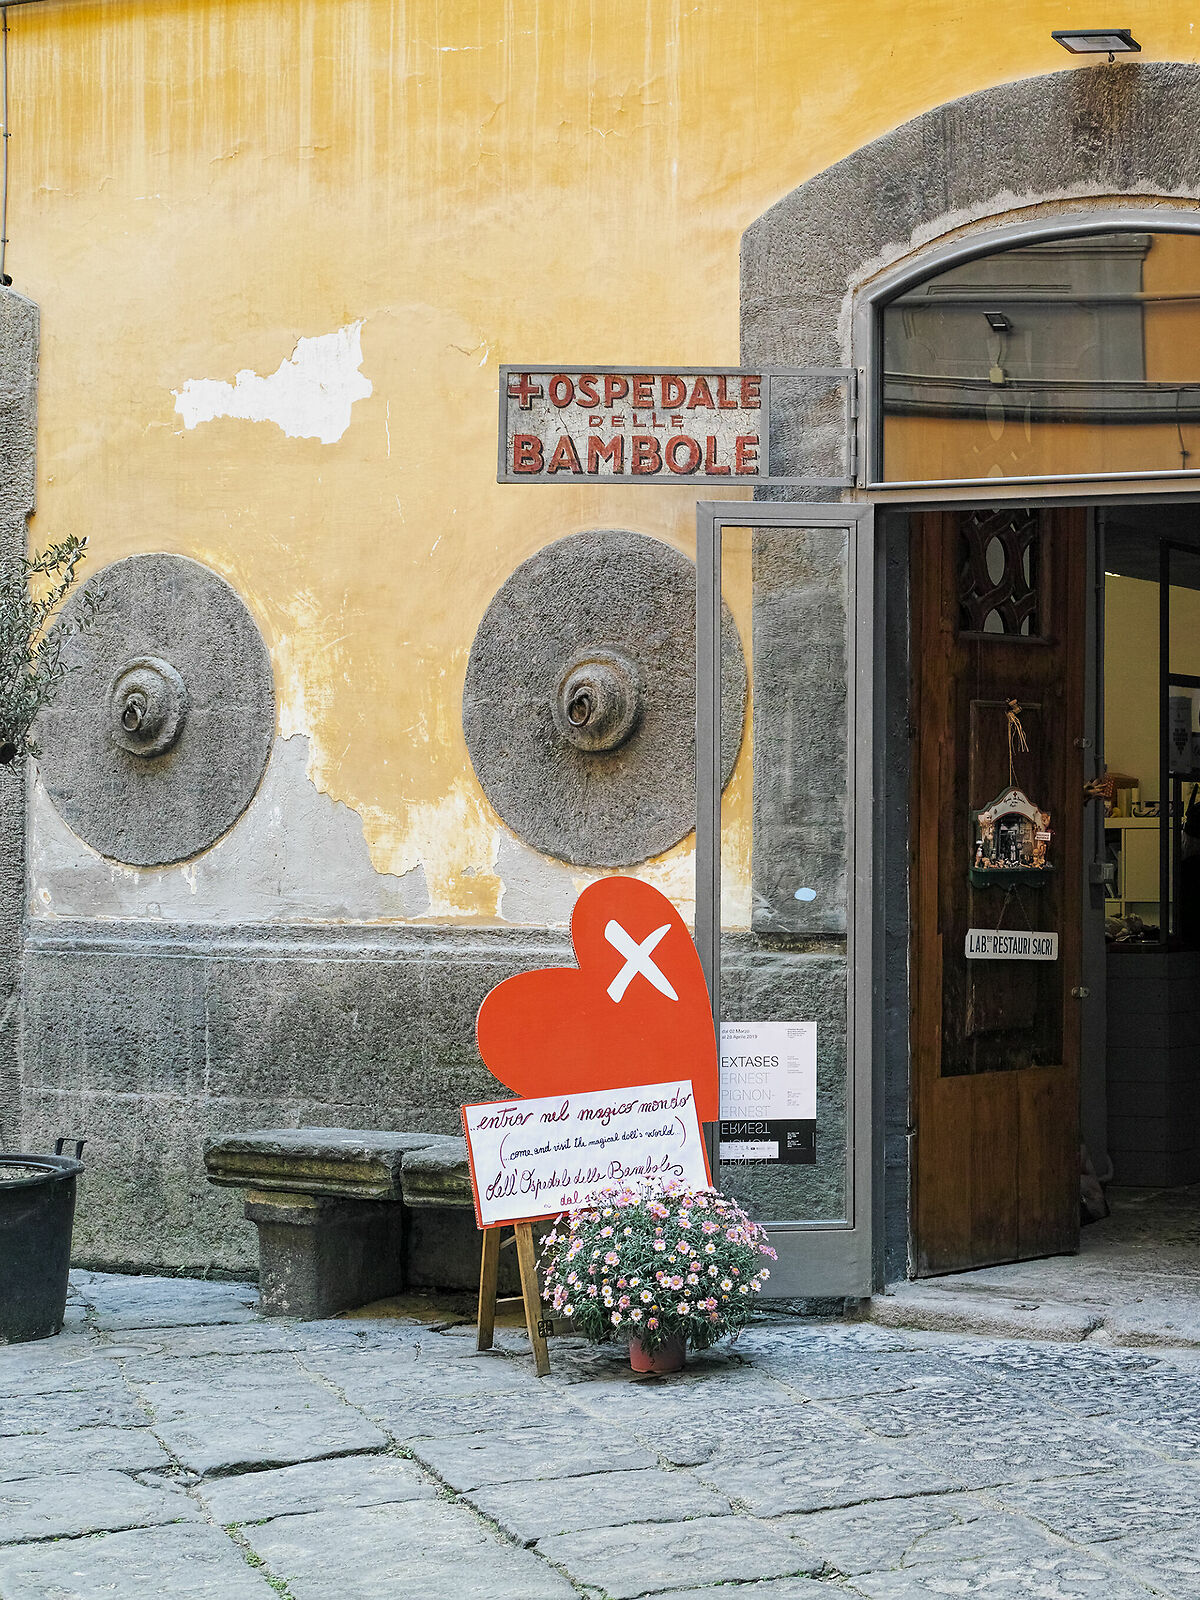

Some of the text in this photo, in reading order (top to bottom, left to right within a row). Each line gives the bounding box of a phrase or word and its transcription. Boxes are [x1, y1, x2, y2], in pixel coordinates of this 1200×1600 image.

[548, 374, 762, 409] OSPEDALE
[589, 414, 685, 428] DELLE
[512, 434, 760, 476] BAMBOLE
[993, 936, 1030, 955] RESTAURI
[1032, 939, 1053, 956] SACRI
[721, 1056, 779, 1067] EXTASES
[721, 1072, 771, 1085] ERNEST
[540, 1099, 570, 1123] nel
[577, 1100, 639, 1126] magico
[637, 1087, 692, 1113] mondo
[721, 1105, 771, 1118] ERNEST
[534, 1143, 552, 1155] and
[553, 1138, 572, 1152] visit
[573, 1136, 588, 1148] the
[588, 1134, 620, 1151] magical
[621, 1128, 643, 1143] doll's
[560, 1190, 583, 1206] dal
